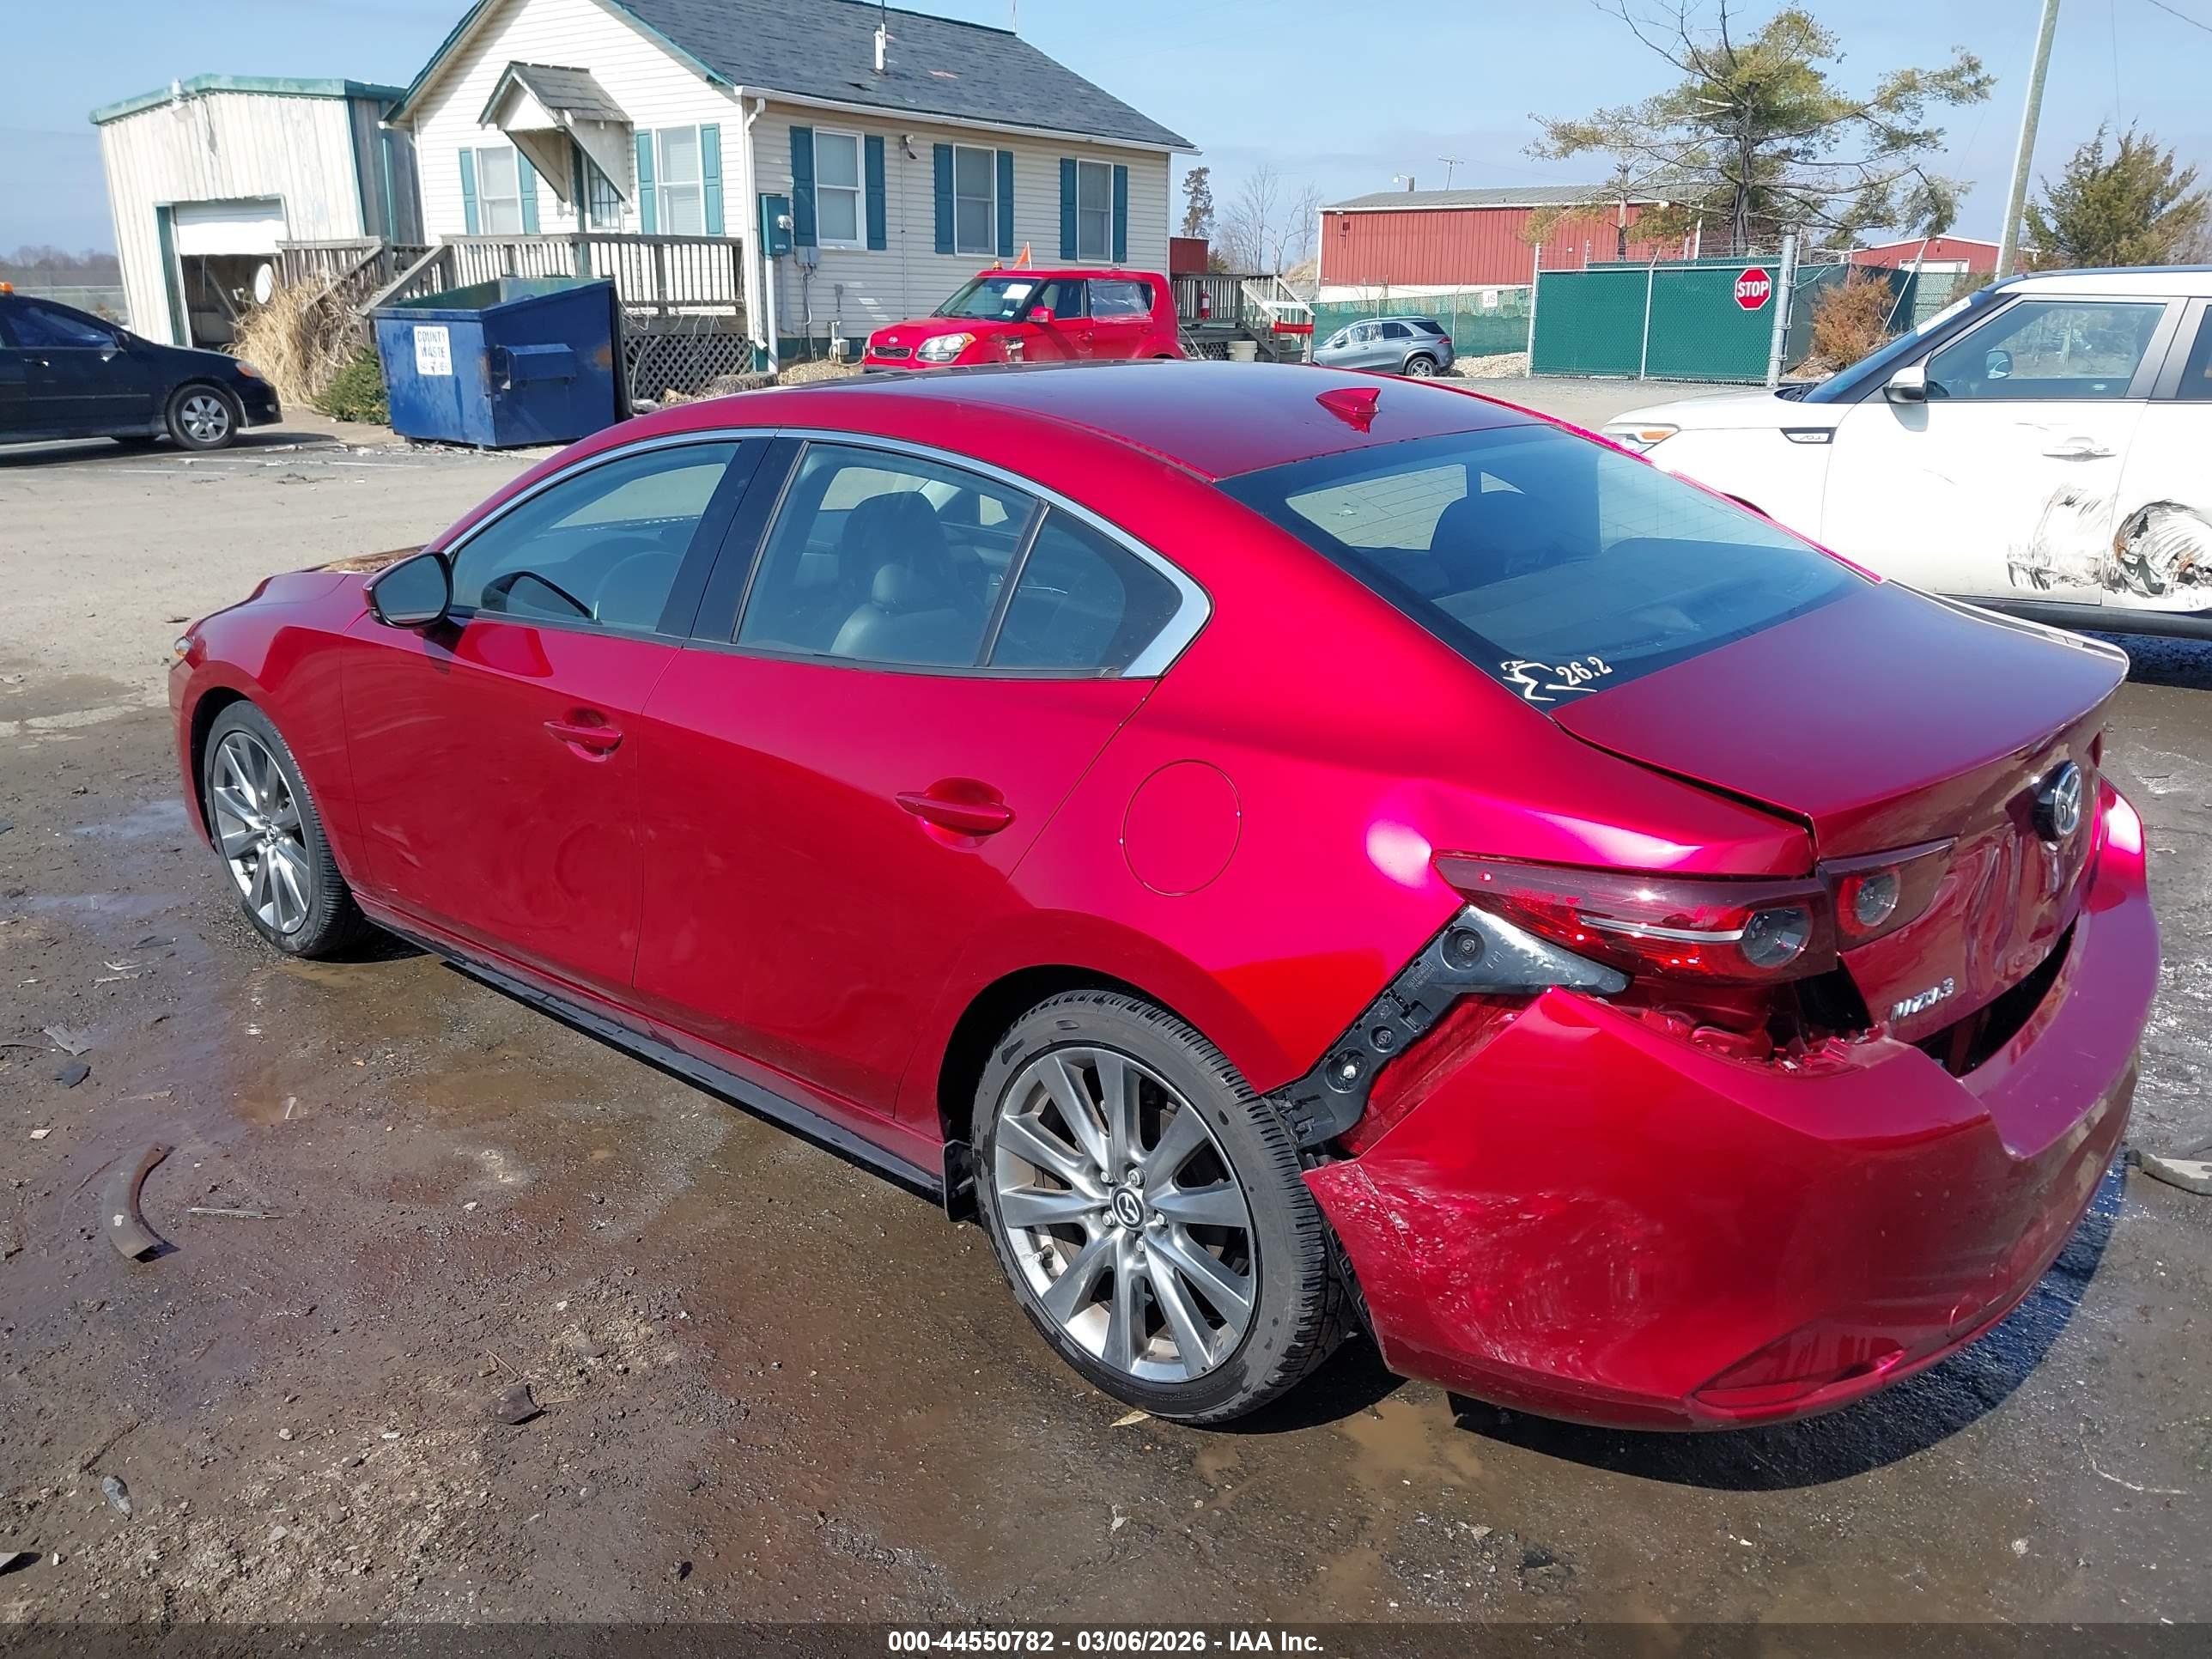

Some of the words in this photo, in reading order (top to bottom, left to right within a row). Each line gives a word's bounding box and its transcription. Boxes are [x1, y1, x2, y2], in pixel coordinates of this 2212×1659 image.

[1737, 280, 1769, 298] STOP
[417, 330, 446, 343] COUNTY
[419, 346, 446, 358] WASTE
[1555, 656, 1613, 686] 26.2
